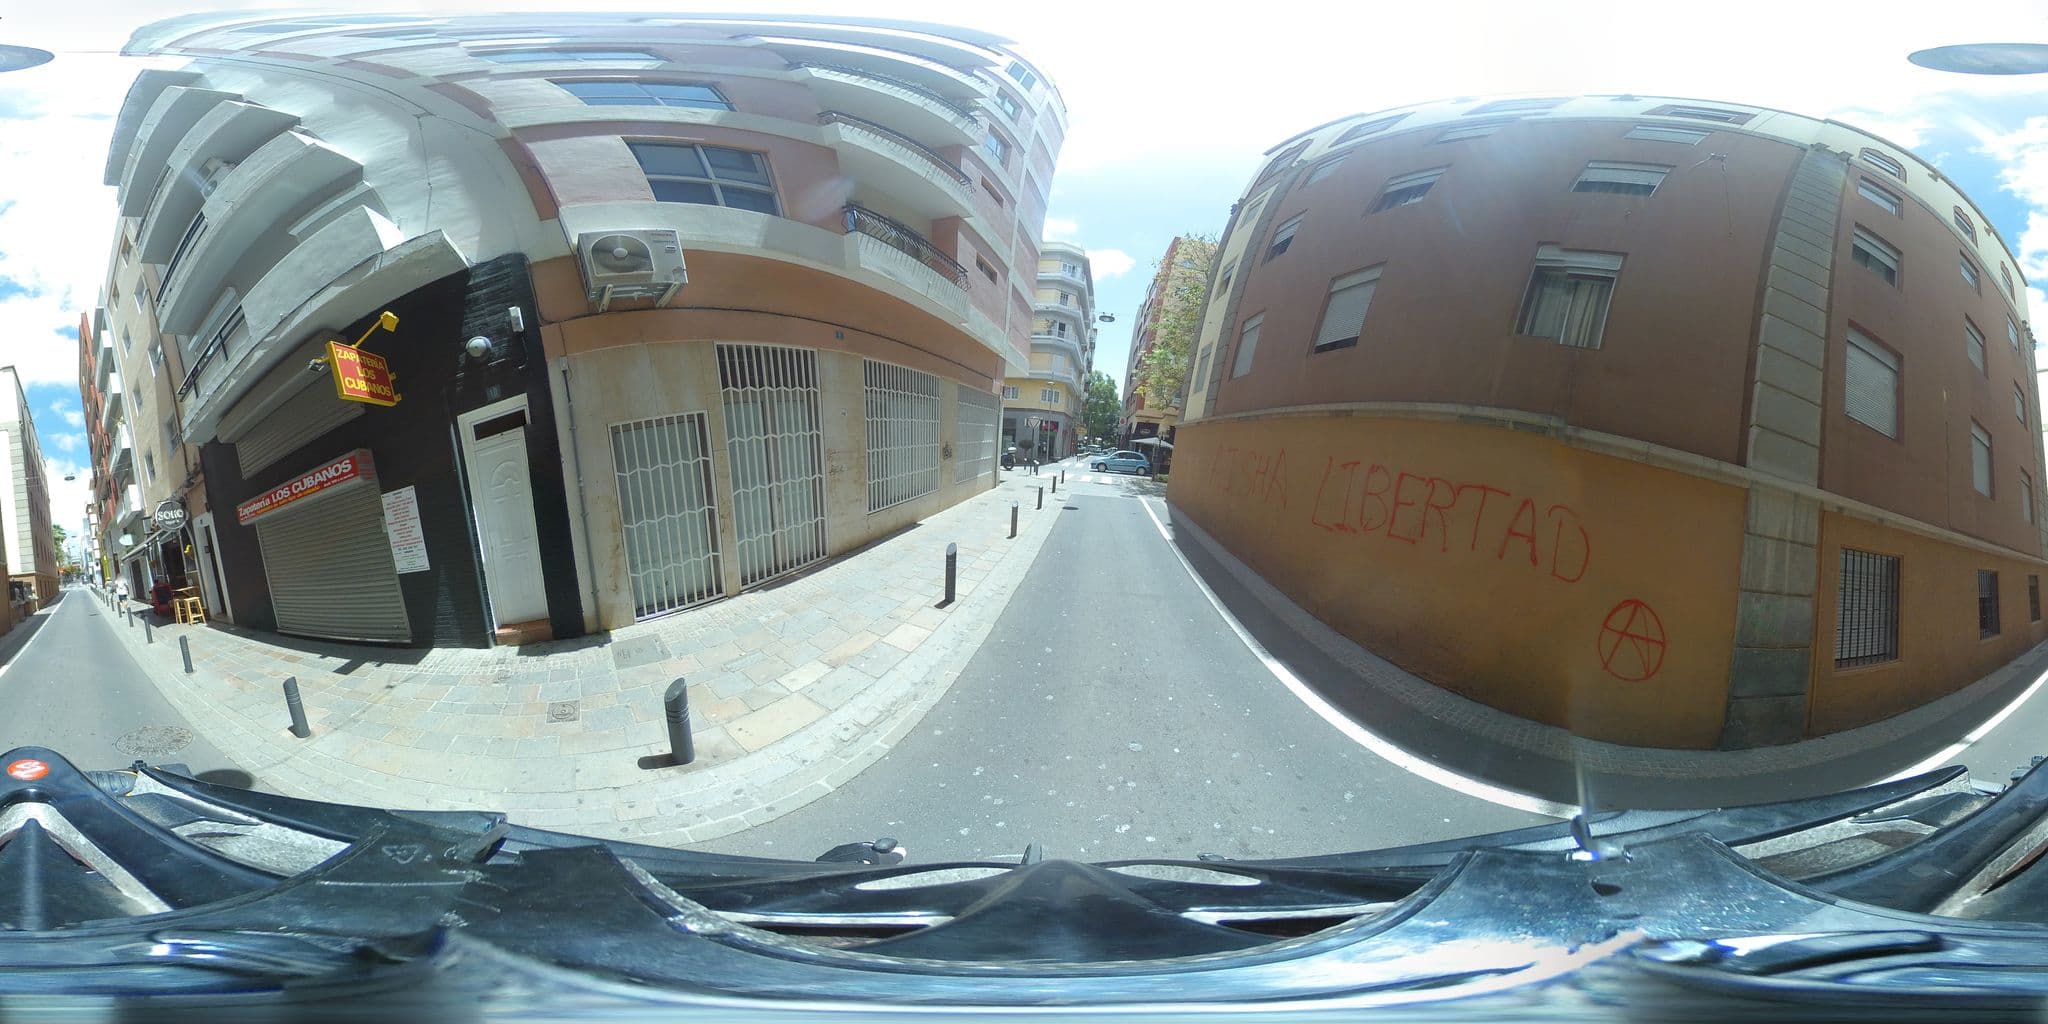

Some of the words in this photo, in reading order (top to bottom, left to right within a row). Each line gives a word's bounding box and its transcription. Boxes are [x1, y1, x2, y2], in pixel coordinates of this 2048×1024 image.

[344, 376, 392, 397] CUBANOS
[357, 366, 376, 380] LOS
[271, 486, 291, 503] LOS
[291, 459, 352, 494] CUBANOS
[1312, 456, 1590, 583] LIBERTAD
